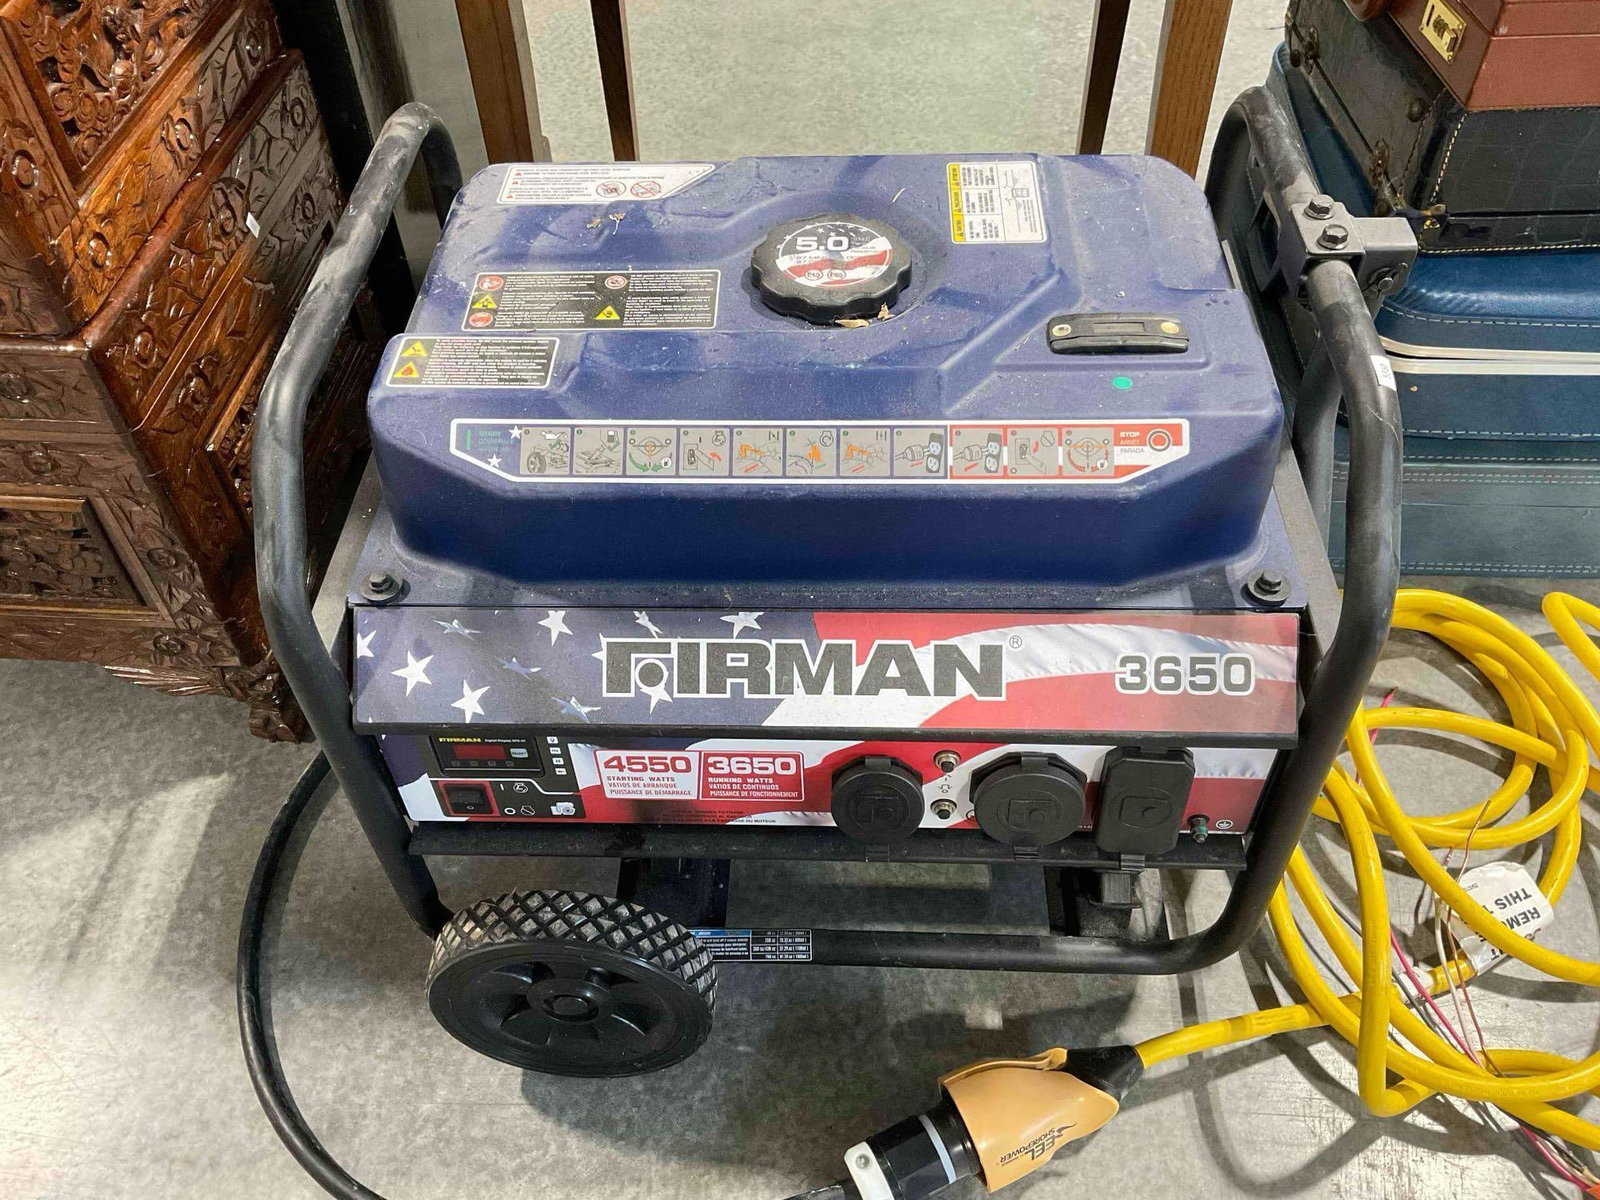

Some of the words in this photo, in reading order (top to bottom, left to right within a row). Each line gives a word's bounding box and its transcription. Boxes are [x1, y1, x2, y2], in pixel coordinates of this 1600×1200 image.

[796, 236, 849, 251] 5.0
[1115, 652, 1256, 696] 3650
[603, 756, 692, 774] 4550
[707, 756, 797, 776] 3650
[1494, 887, 1532, 910] THIS
[1501, 907, 1541, 930] REM
[1000, 1127, 1056, 1163] SHOREPOWER
[1024, 1135, 1056, 1161] EEL
